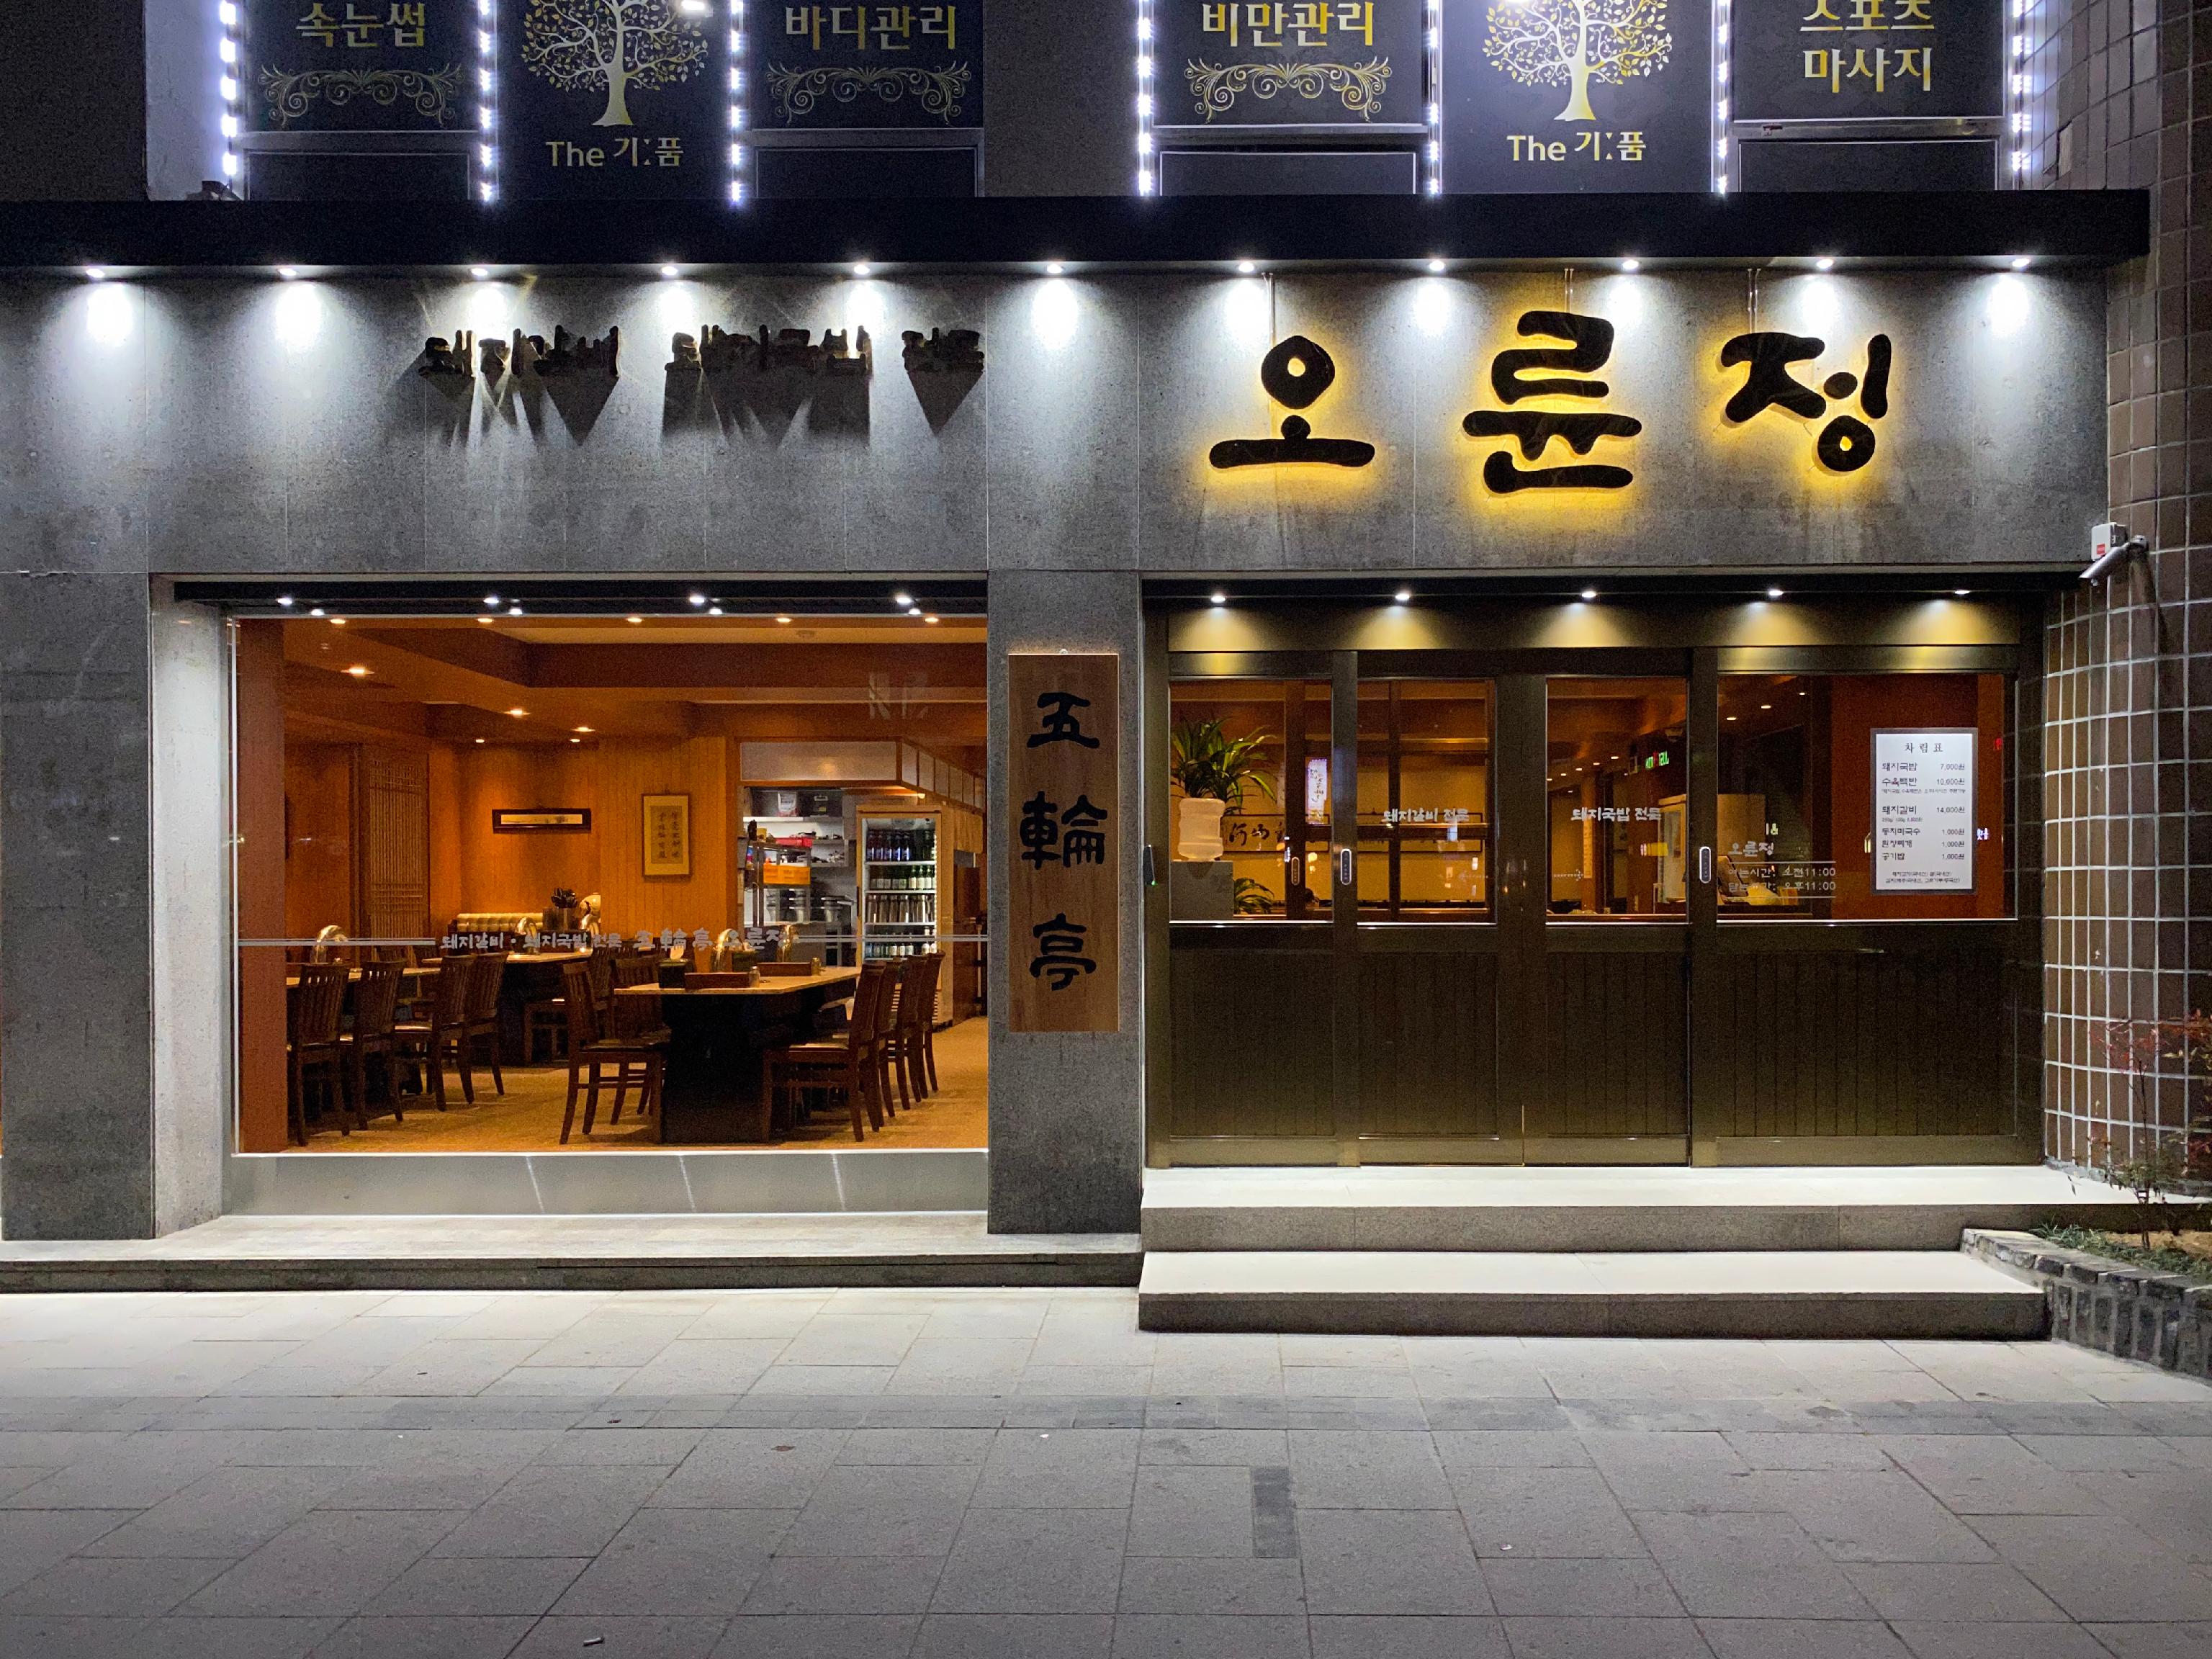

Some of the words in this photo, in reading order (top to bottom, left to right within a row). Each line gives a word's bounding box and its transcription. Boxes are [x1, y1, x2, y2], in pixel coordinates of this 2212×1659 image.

[297, 2, 425, 48] 속눈썹
[786, 6, 956, 50] 바디관리
[1202, 3, 1373, 48] 비만관리
[1804, 48, 1933, 93] 마사지
[545, 141, 604, 166] The
[1506, 135, 1566, 161] The
[1208, 310, 1894, 495] 오륜정
[1881, 762, 1917, 771] 돼지국밥
[1881, 778, 1917, 787] 수육백반
[1382, 807, 1439, 822] 돼지갈비
[1570, 806, 1631, 822] 돼지국밥
[1635, 806, 1661, 822] 전문
[1881, 805, 1917, 815] 돼지갈비
[1019, 691, 1109, 991] 五輪亭
[1728, 840, 1774, 858] 오륜정
[1881, 852, 1905, 861] 공기밥
[440, 932, 504, 950] 돼지갈비
